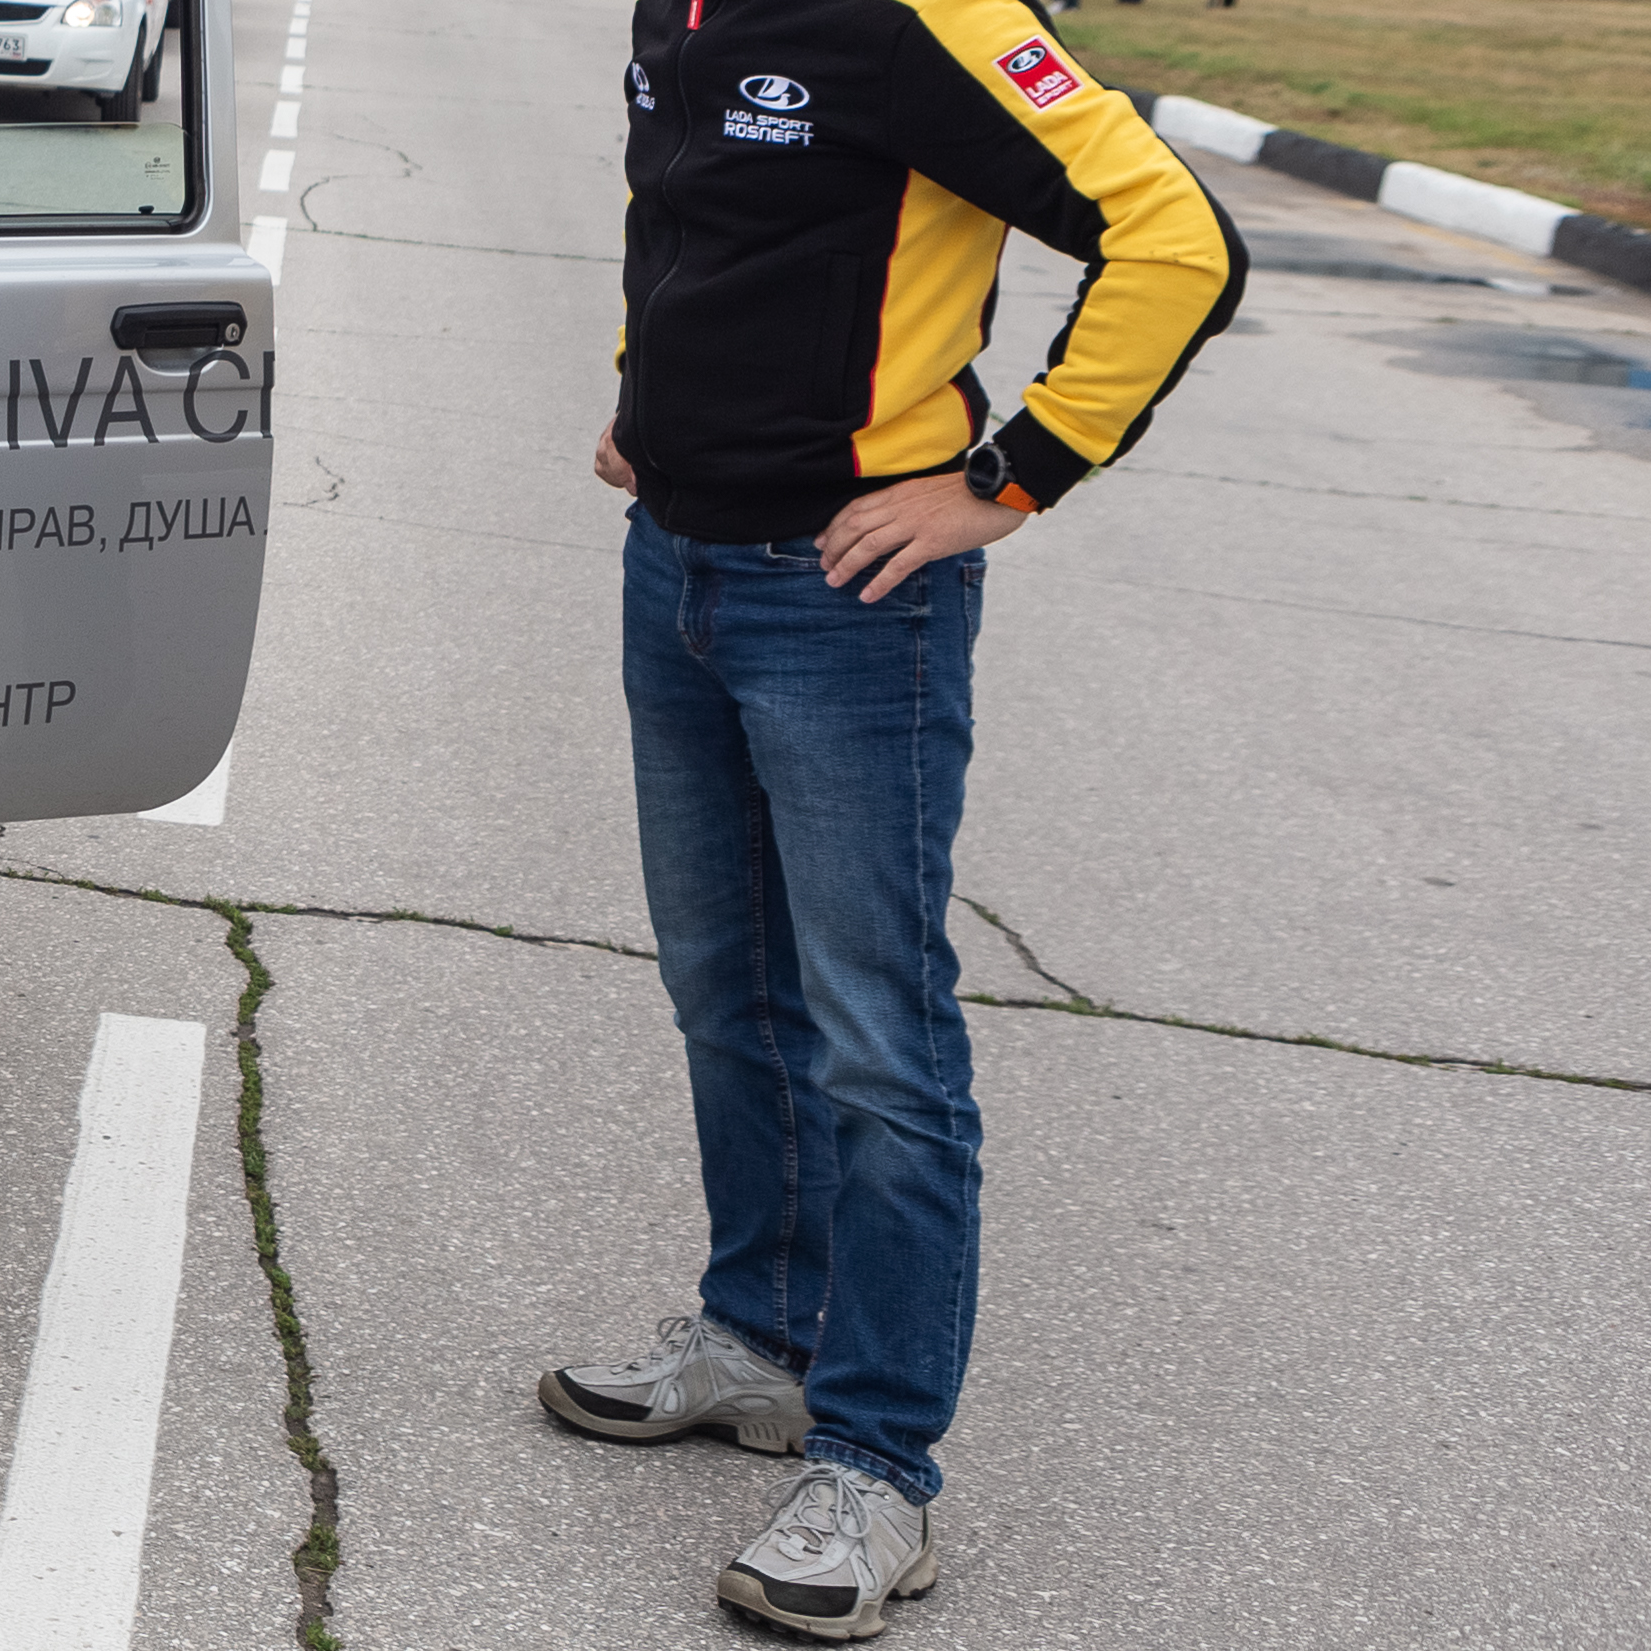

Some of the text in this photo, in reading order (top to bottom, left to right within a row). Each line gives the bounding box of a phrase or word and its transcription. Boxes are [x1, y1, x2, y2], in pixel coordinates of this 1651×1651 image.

[1025, 70, 1069, 99] LADA
[724, 121, 815, 147] ROSNEFT
[725, 109, 814, 132] LADA SPORT
[118, 495, 256, 553] ДУША
